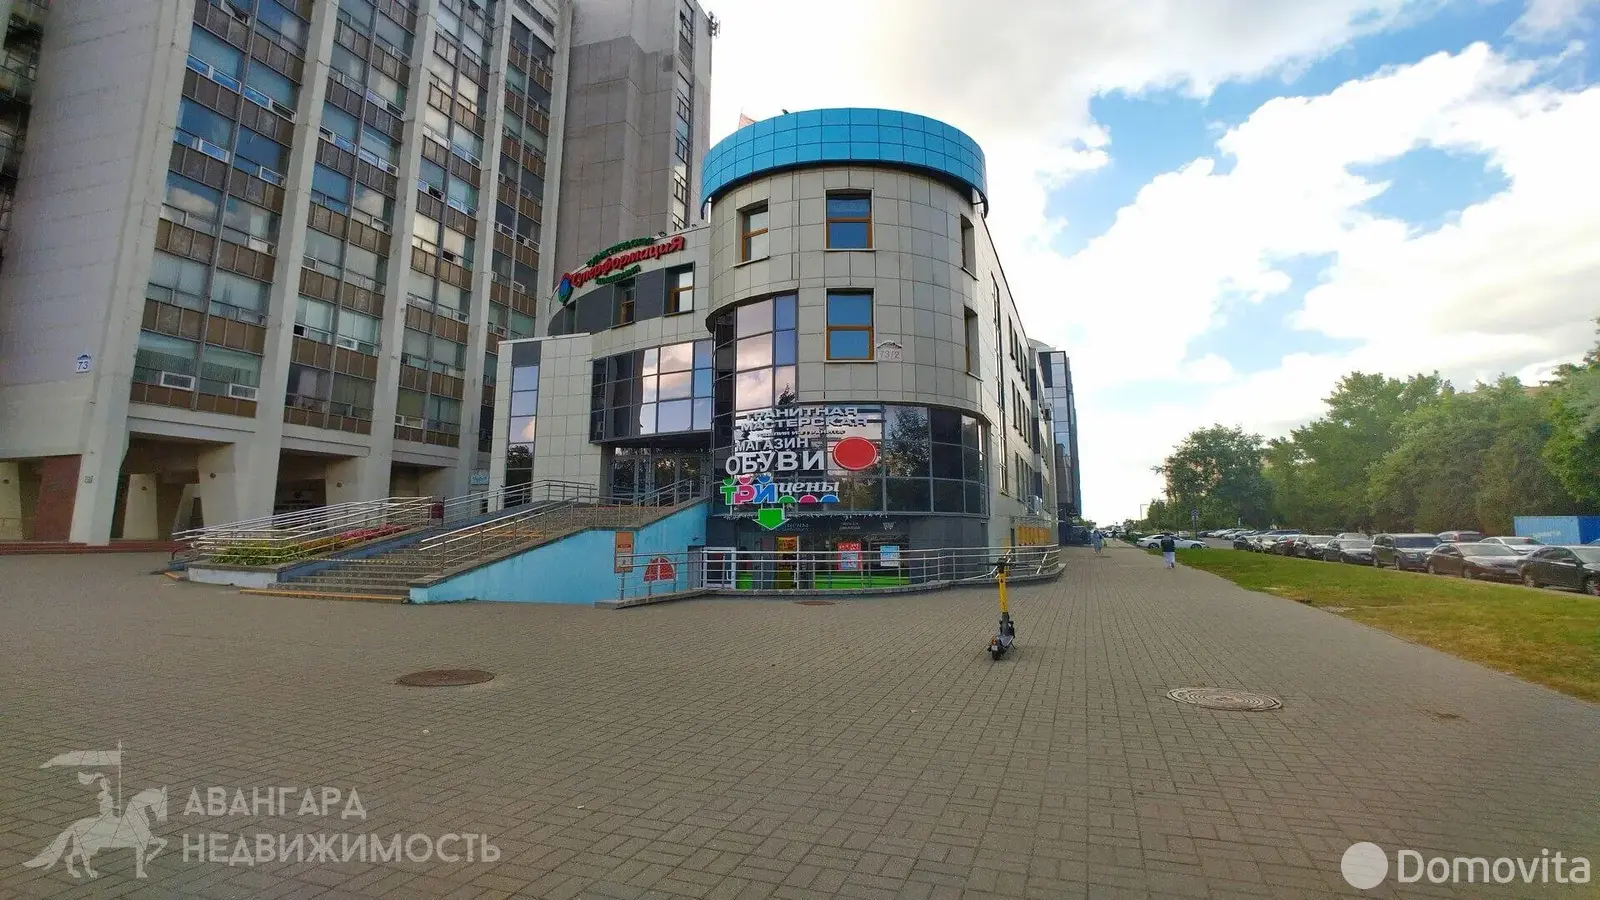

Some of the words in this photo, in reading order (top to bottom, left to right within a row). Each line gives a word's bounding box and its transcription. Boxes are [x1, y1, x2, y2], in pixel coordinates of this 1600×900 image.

[77, 360, 89, 370] 73
[745, 406, 858, 421] ГРАНИТНАЯ
[740, 416, 868, 432] МАСТЕРСКАЯ
[735, 438, 809, 452] МАГАЗИН
[725, 450, 825, 475] ОБУВИ
[720, 478, 778, 505] ТРИ
[778, 481, 840, 496] цены
